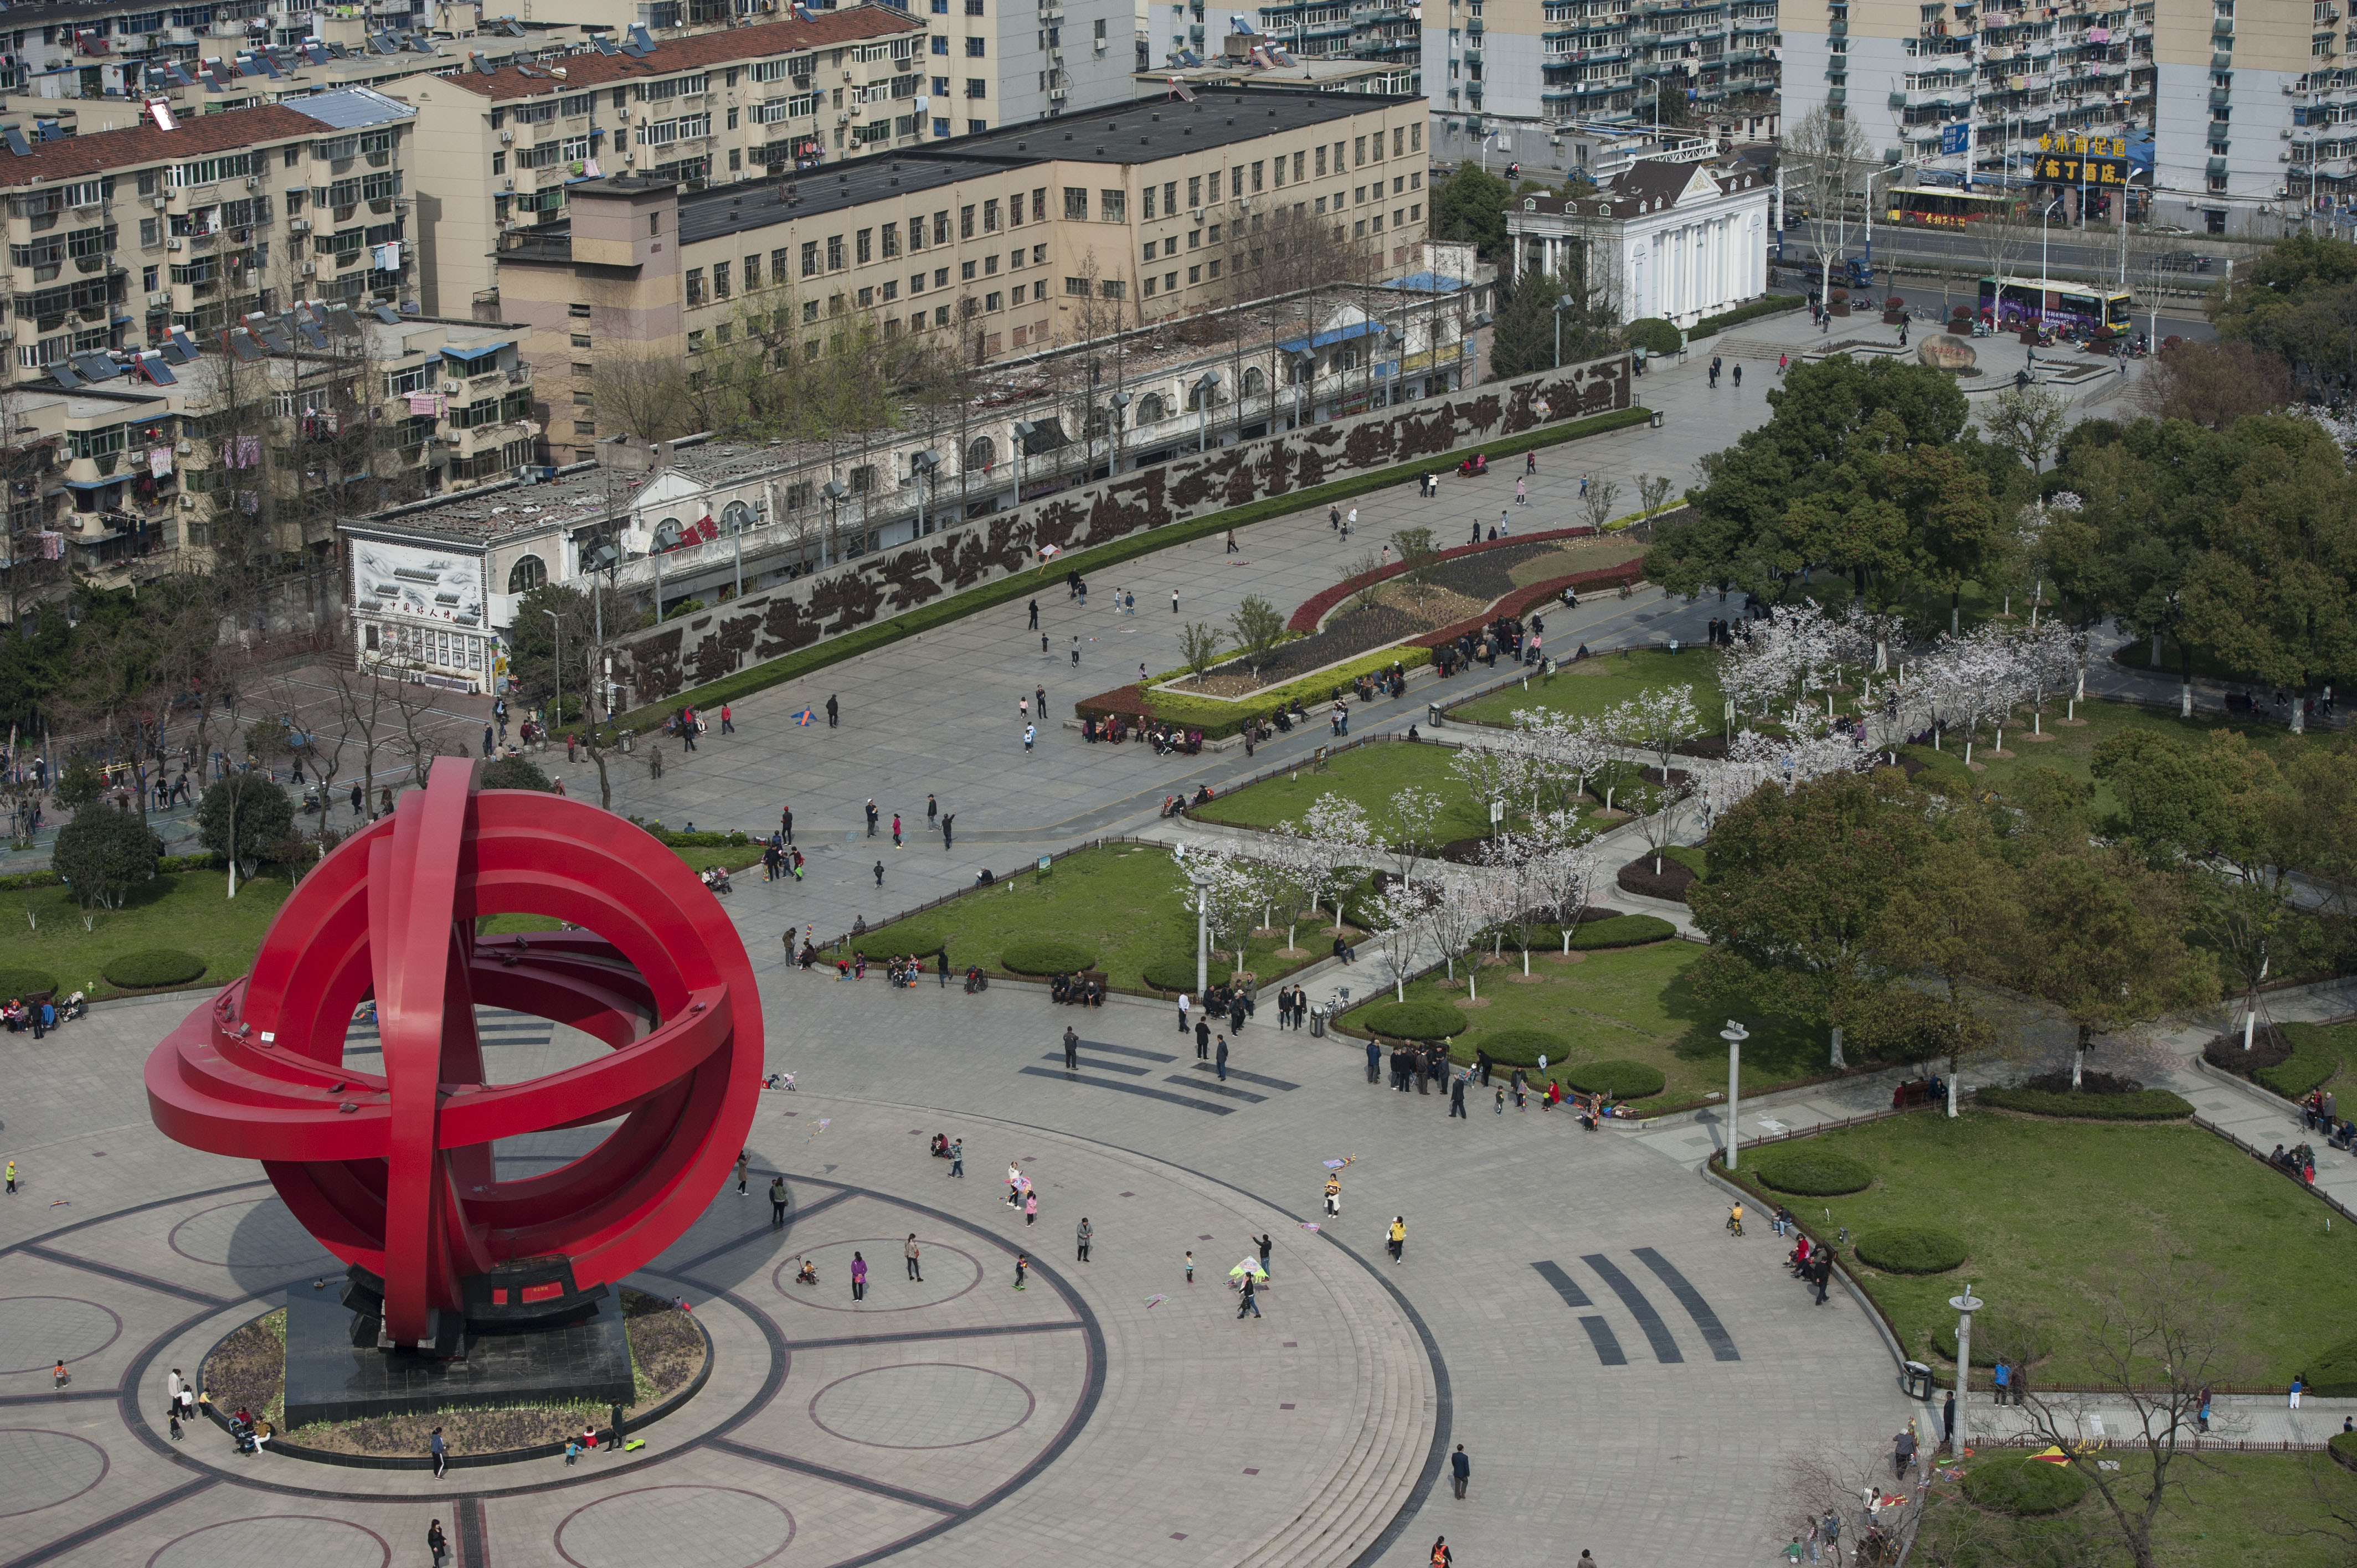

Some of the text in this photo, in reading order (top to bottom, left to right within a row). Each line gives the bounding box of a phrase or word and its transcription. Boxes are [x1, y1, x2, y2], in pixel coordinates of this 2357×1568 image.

[2046, 159, 2116, 183] 布丁酒店
[390, 600, 450, 619] 中国好人榜
